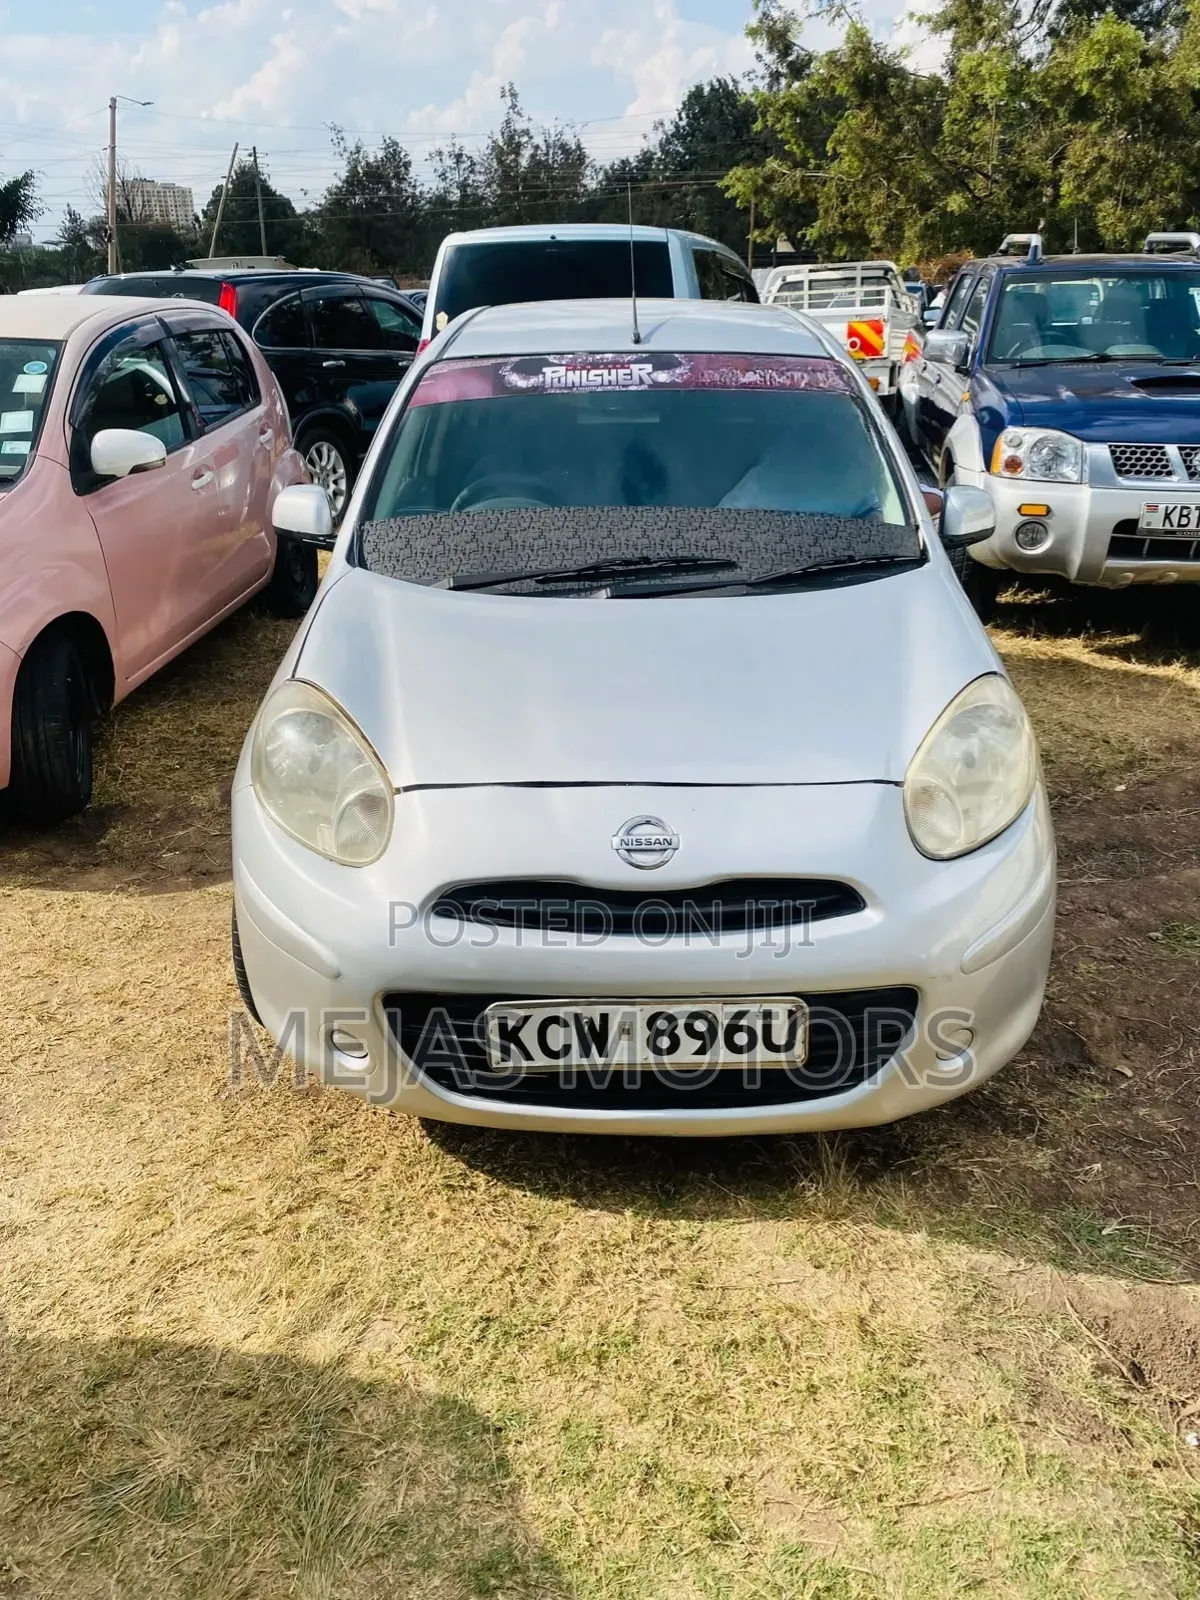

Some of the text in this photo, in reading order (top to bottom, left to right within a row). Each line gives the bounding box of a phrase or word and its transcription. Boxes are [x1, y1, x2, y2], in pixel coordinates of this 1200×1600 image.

[542, 363, 653, 388] PUNISHER
[620, 838, 673, 847] NISSAN
[498, 1008, 797, 1062] KCW 896U
